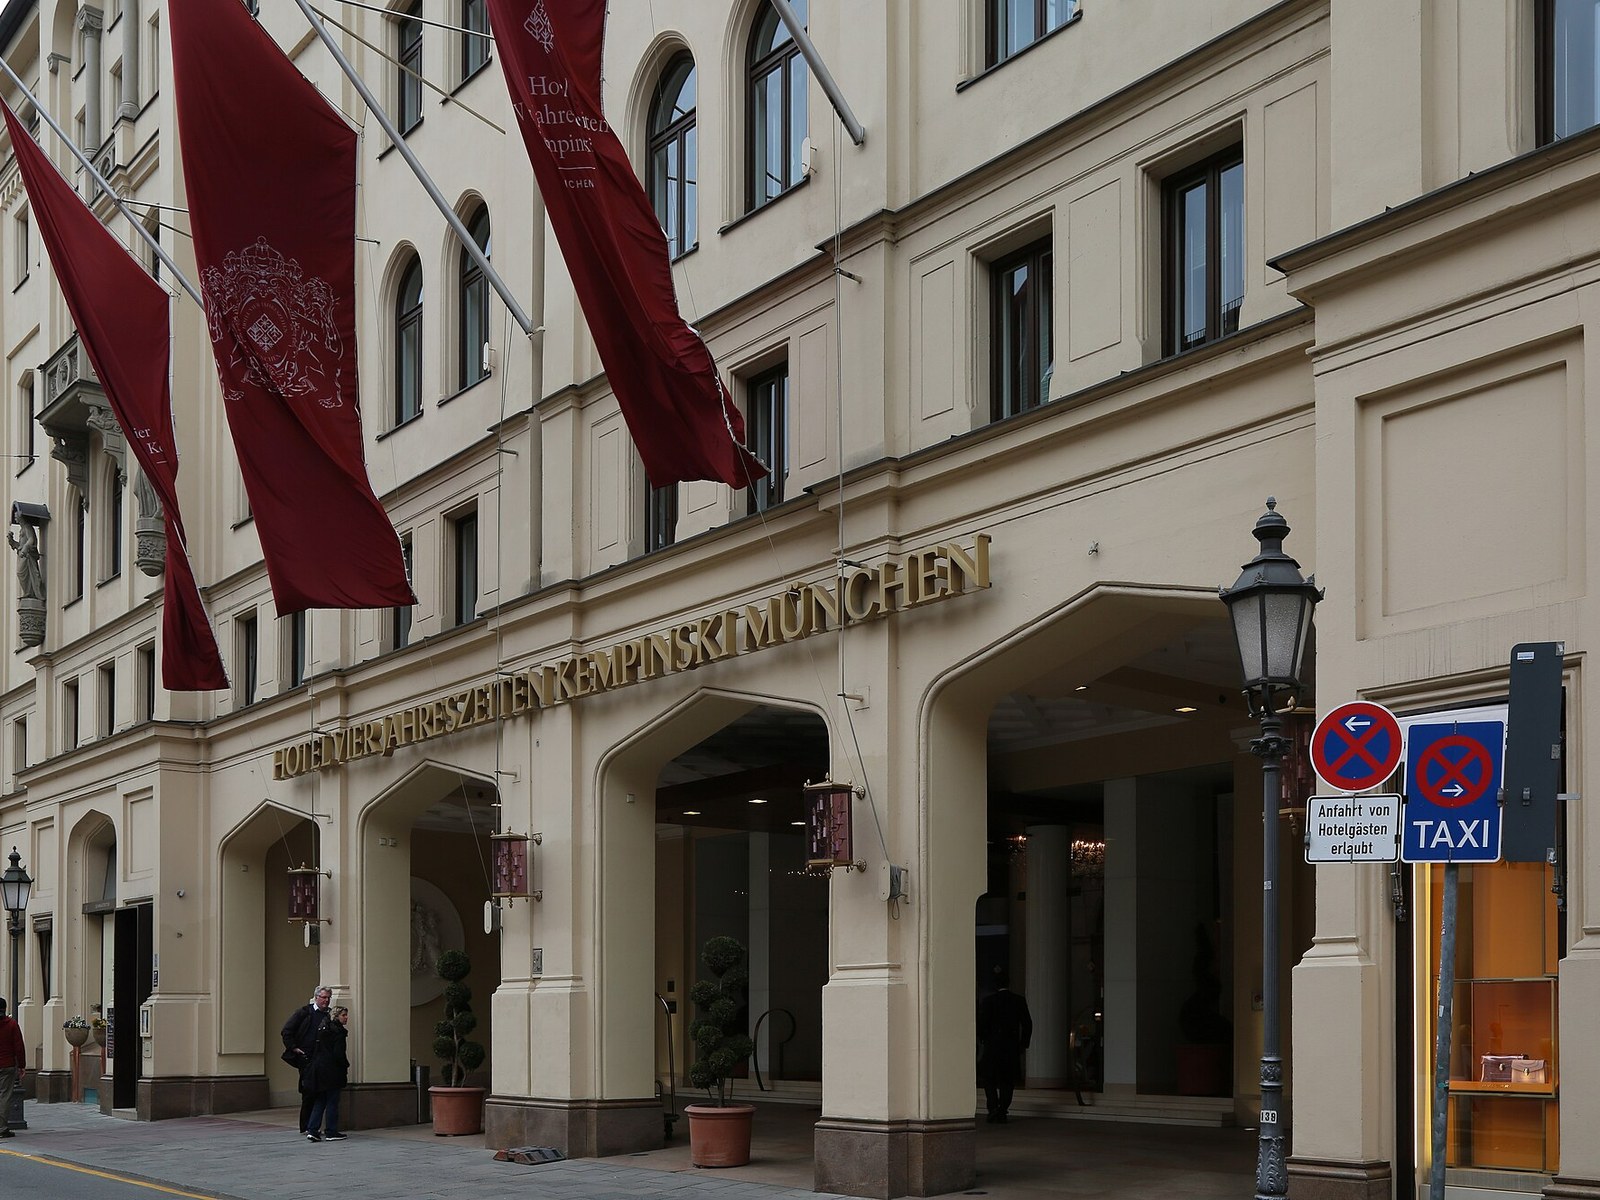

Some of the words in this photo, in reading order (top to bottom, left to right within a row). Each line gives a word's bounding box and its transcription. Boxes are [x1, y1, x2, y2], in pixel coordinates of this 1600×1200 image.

[272, 736, 337, 781] HOTEL
[331, 722, 384, 766] VIER
[381, 666, 555, 758] JAHRESZEITEN
[555, 611, 739, 703] KEMPINSKI
[744, 532, 992, 651] MÜNCHEN
[1318, 804, 1363, 818] Anfahrt
[1369, 805, 1390, 816] von
[1318, 822, 1388, 838] Hotelgästen
[1412, 819, 1490, 849] TAXI
[1331, 841, 1374, 855] erlaubt
[1261, 1111, 1276, 1122] 139
